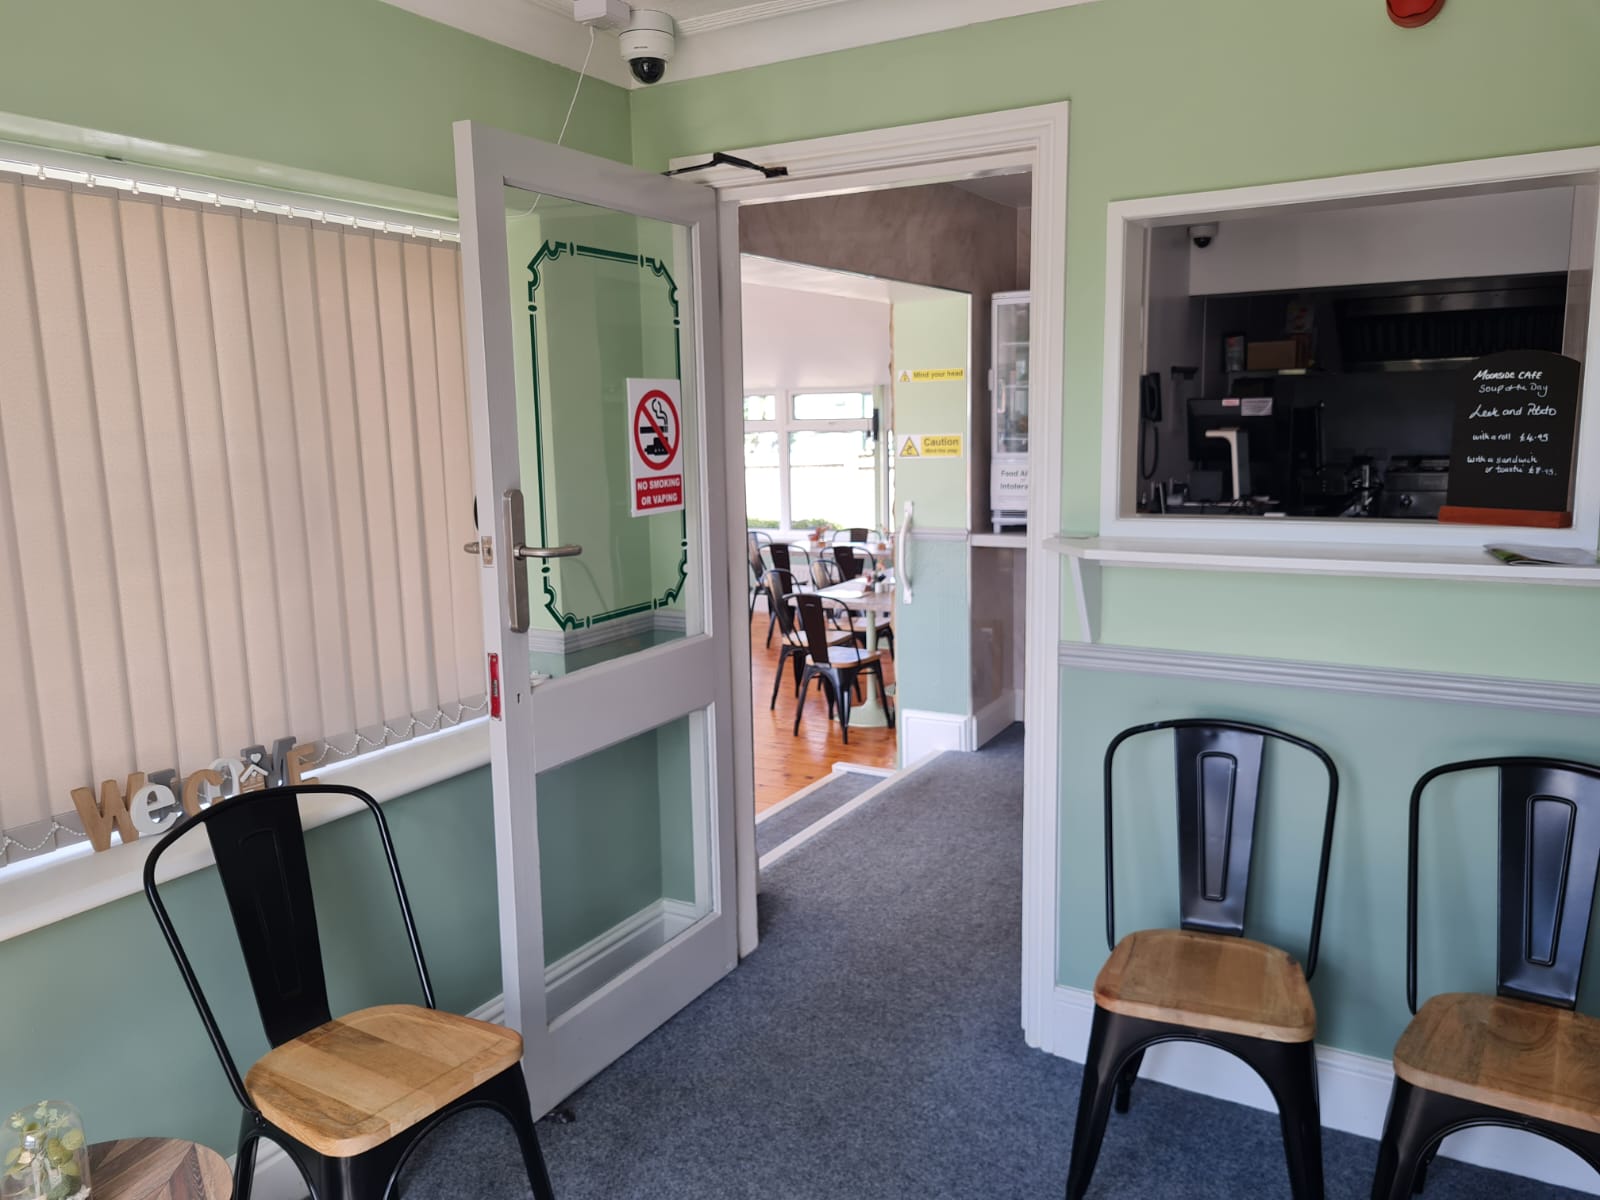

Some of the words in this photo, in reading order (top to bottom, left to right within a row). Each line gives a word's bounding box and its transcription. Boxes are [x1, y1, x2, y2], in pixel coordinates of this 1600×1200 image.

[931, 371, 945, 380] your
[946, 368, 964, 377] head
[1479, 384, 1504, 394] Soup
[1529, 382, 1549, 398] Day
[1502, 406, 1523, 416] and
[1472, 430, 1489, 441] with
[1497, 432, 1511, 441] roll
[923, 437, 960, 447] Caution
[1466, 455, 1486, 464] with
[1495, 453, 1537, 464] sandwich
[1000, 469, 1018, 478] Food
[637, 480, 648, 491] NO
[649, 478, 680, 489] SMOKING
[641, 496, 652, 506] OR
[652, 493, 677, 504] VAPING
